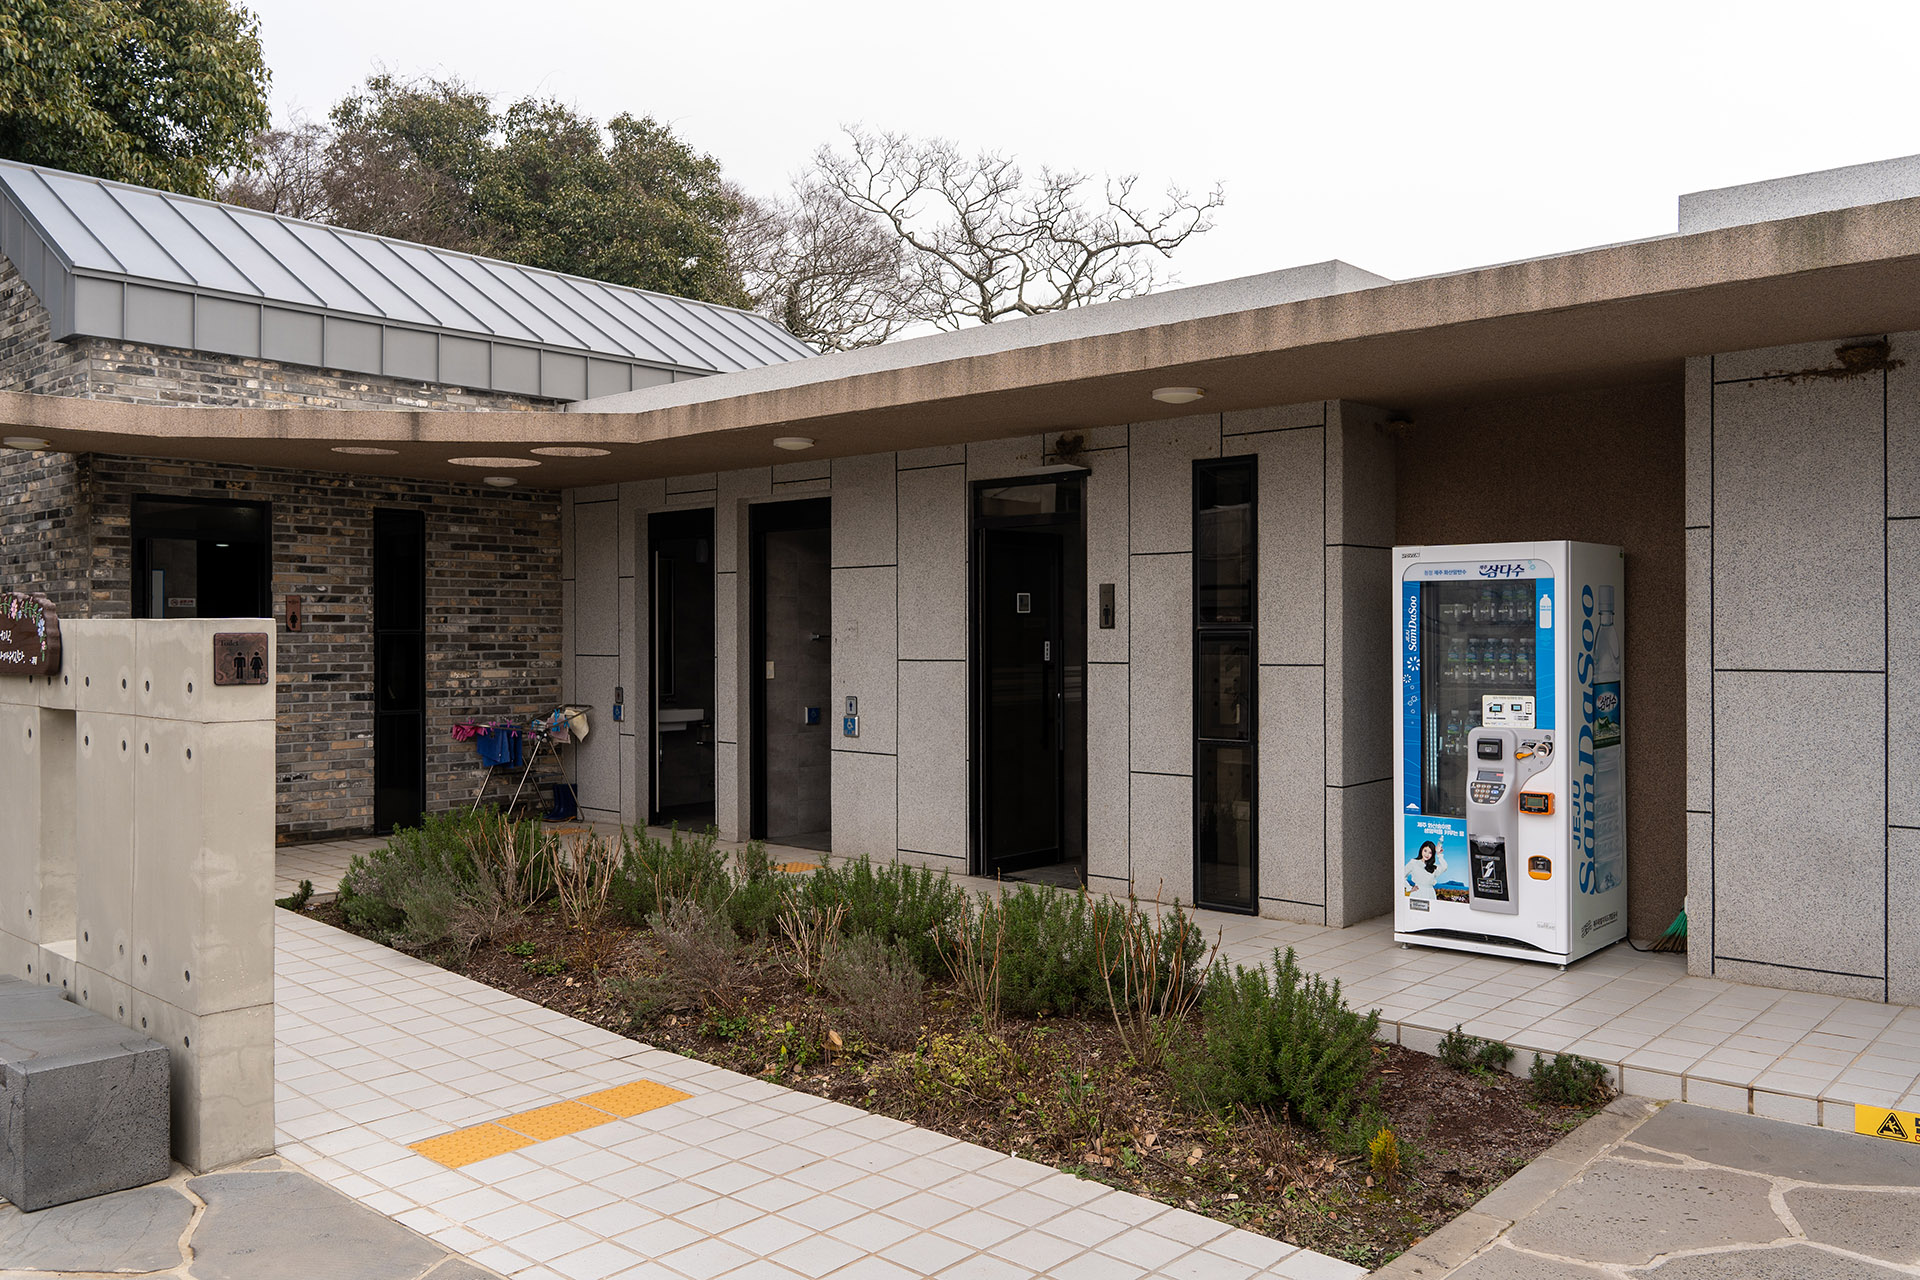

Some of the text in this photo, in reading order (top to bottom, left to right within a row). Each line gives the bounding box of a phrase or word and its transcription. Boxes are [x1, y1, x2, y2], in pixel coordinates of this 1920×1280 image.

[1485, 564, 1524, 578] 삼다수
[220, 639, 239, 647] Toilet
[1408, 595, 1417, 652] SamDaSoo
[1577, 584, 1594, 896] SamDaSoo
[1573, 780, 1581, 850] JEJU
